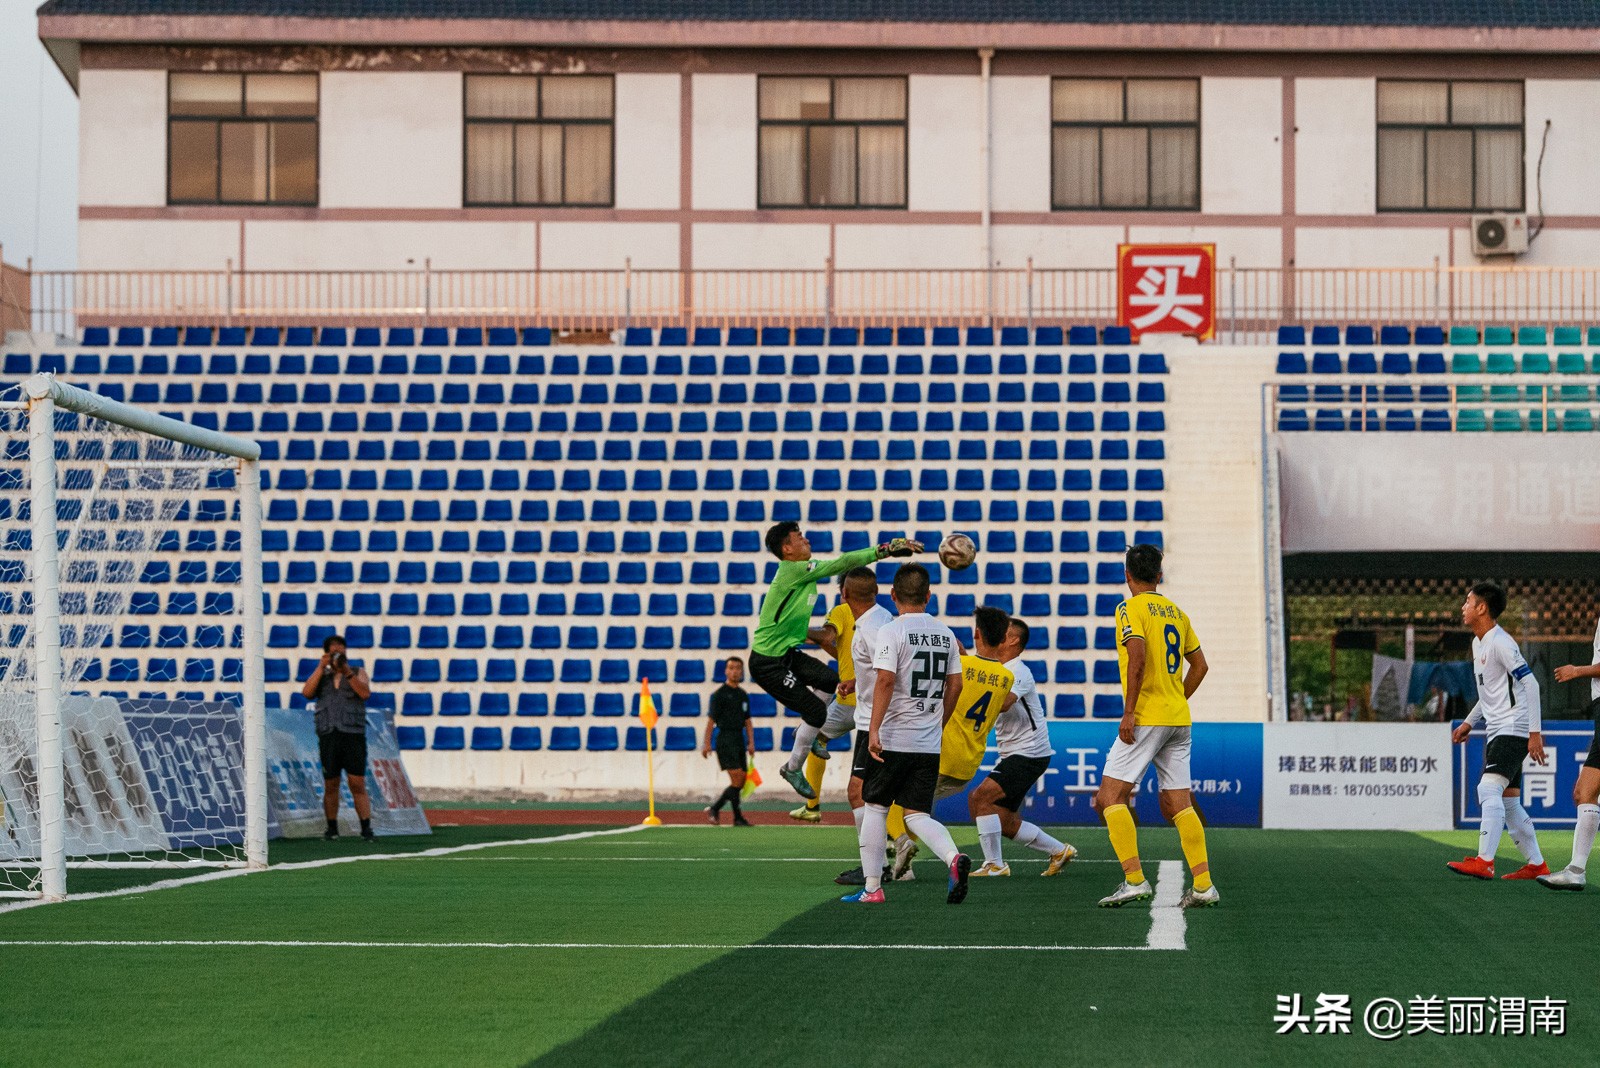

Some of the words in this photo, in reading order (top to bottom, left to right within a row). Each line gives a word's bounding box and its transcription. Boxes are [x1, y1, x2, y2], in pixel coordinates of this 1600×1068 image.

[1129, 255, 1204, 329] 买
[1164, 624, 1181, 674] 8
[910, 651, 949, 699] 29
[965, 690, 993, 732] 4
[1278, 755, 1438, 773] 捧起来就能喝的水
